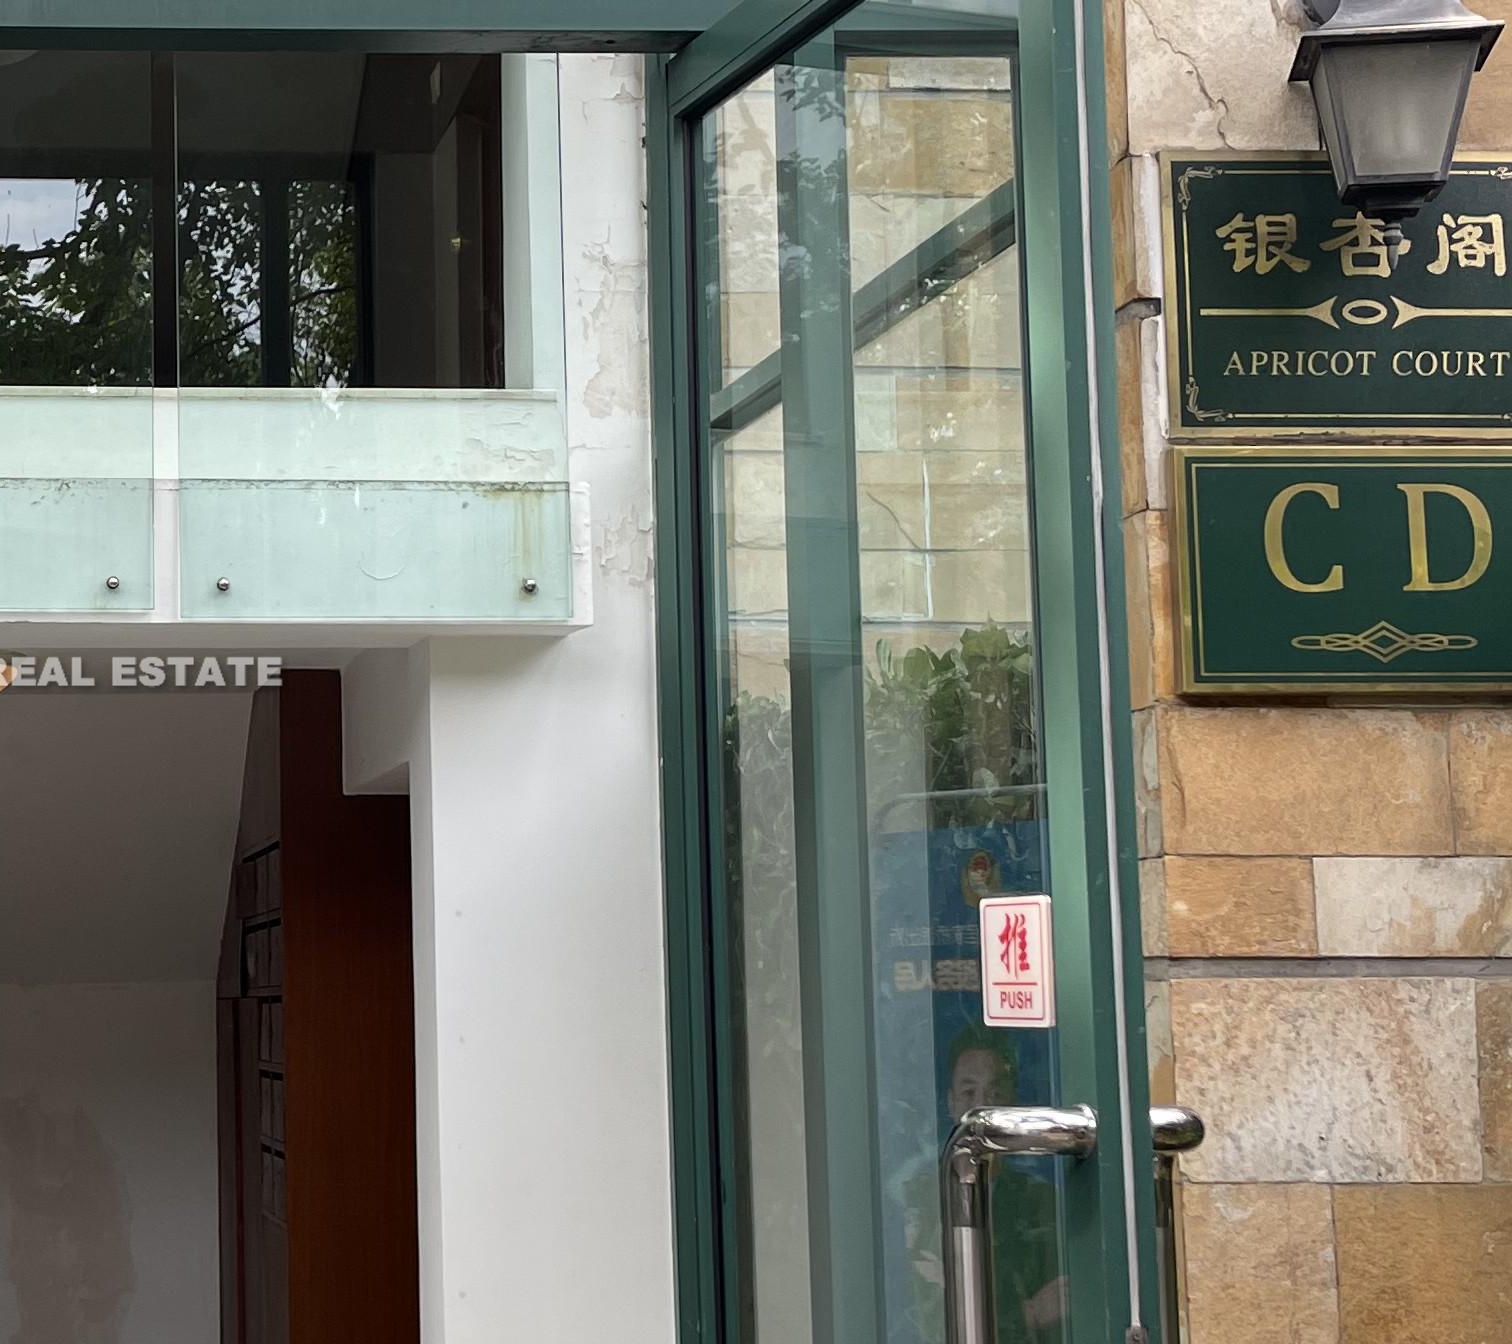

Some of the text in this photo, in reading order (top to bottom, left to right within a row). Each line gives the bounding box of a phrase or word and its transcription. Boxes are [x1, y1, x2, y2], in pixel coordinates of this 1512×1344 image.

[1215, 210, 1507, 278] 银杏阁
[1223, 350, 1511, 378] APRICOT COURT
[998, 912, 1030, 980] 推
[999, 991, 1033, 1009] PUSH
